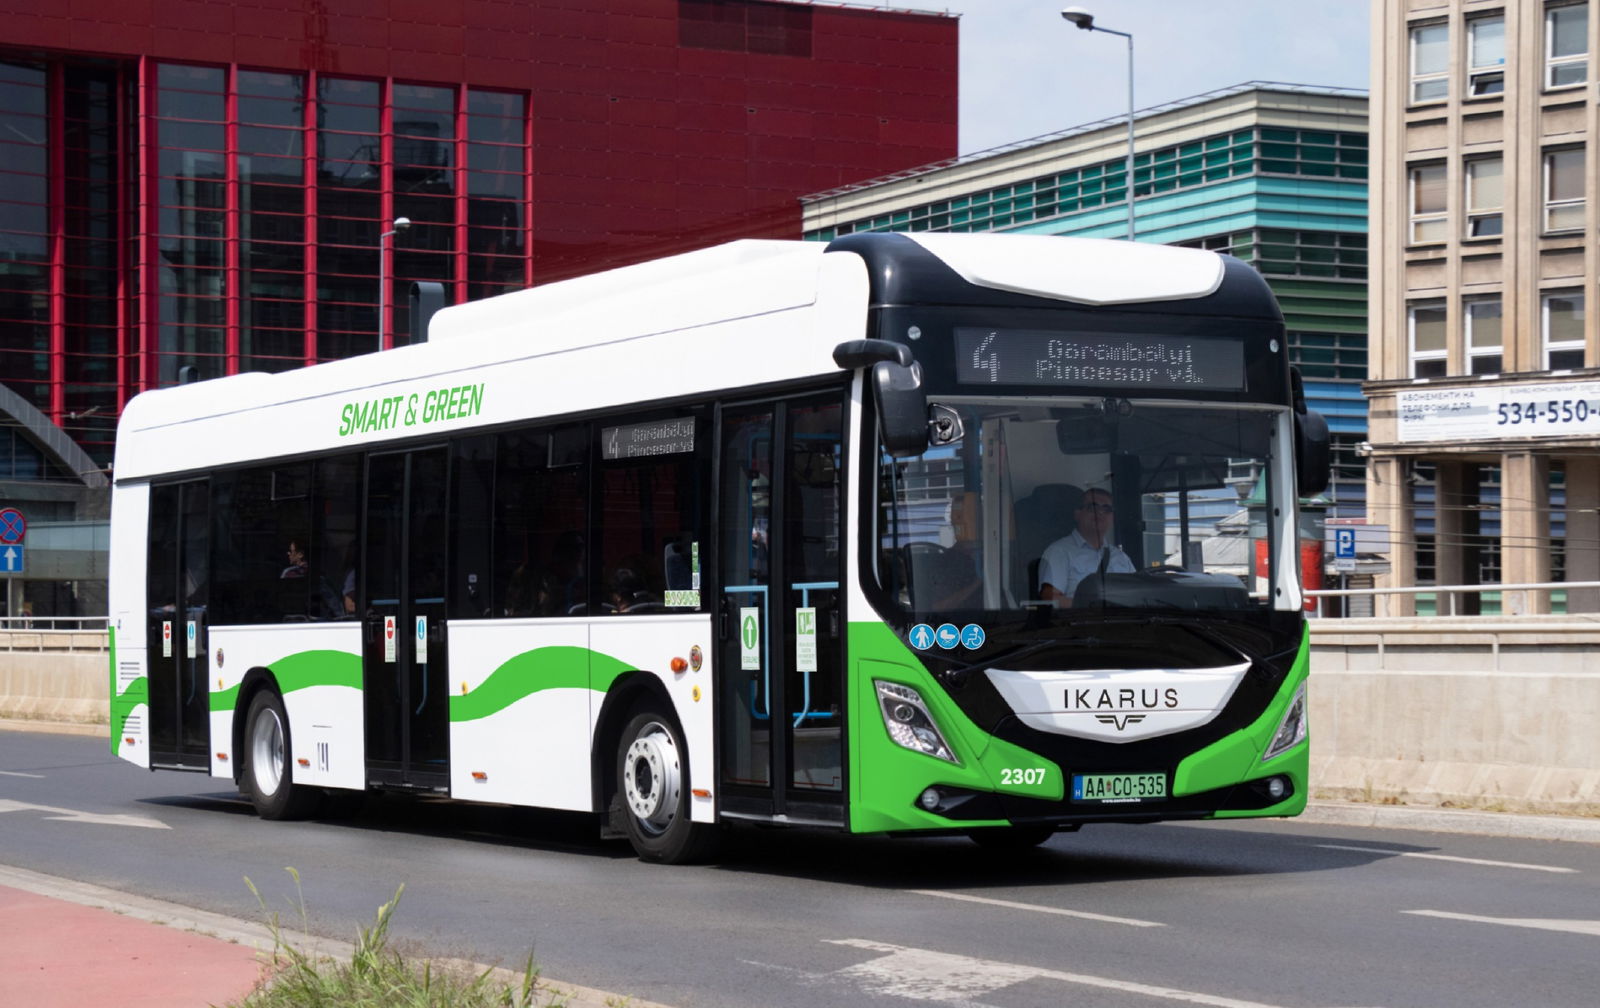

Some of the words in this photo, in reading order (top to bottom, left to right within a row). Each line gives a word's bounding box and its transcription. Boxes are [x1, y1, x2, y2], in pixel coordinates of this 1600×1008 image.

[973, 332, 1000, 382] 4
[1036, 359, 1158, 382] Pincesor
[339, 395, 404, 436] SMART
[404, 393, 419, 426] &
[422, 383, 485, 423] GREEN
[1497, 399, 1600, 425] 534-550-
[608, 428, 621, 459] 4
[1339, 531, 1352, 555] P
[1063, 688, 1179, 709] IKARUS
[1000, 768, 1046, 785] 2307
